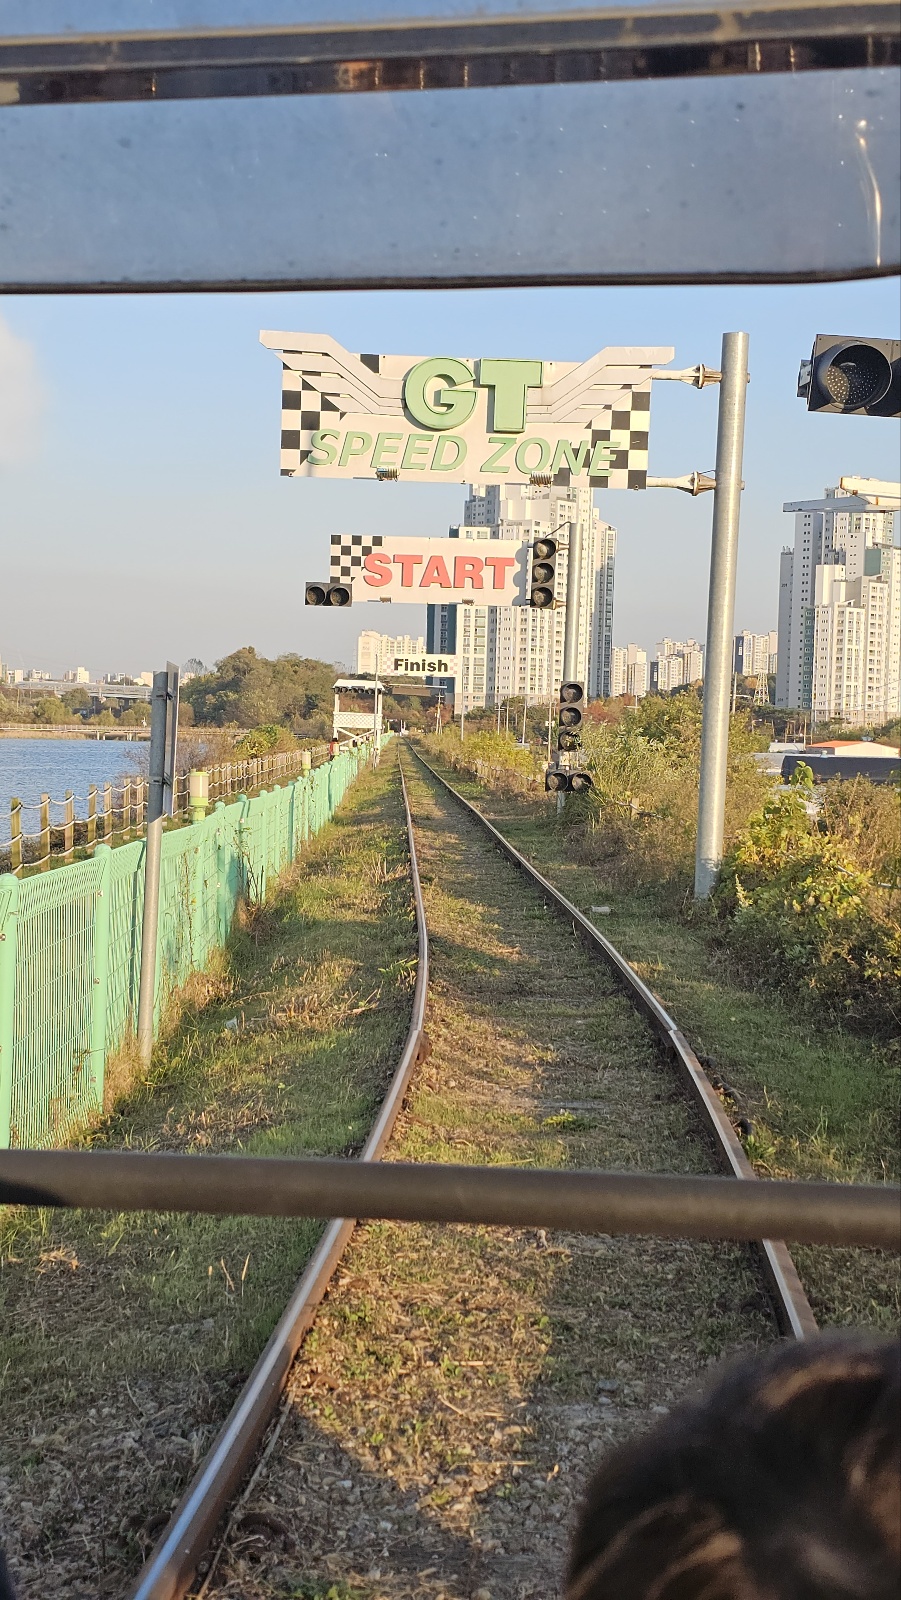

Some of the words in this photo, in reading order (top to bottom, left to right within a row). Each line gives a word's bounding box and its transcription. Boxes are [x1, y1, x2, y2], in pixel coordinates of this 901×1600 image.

[404, 356, 544, 433] GT
[306, 428, 468, 471] SPEED
[480, 437, 621, 478] ZONE
[363, 552, 515, 590] START
[393, 658, 449, 673] Finish
